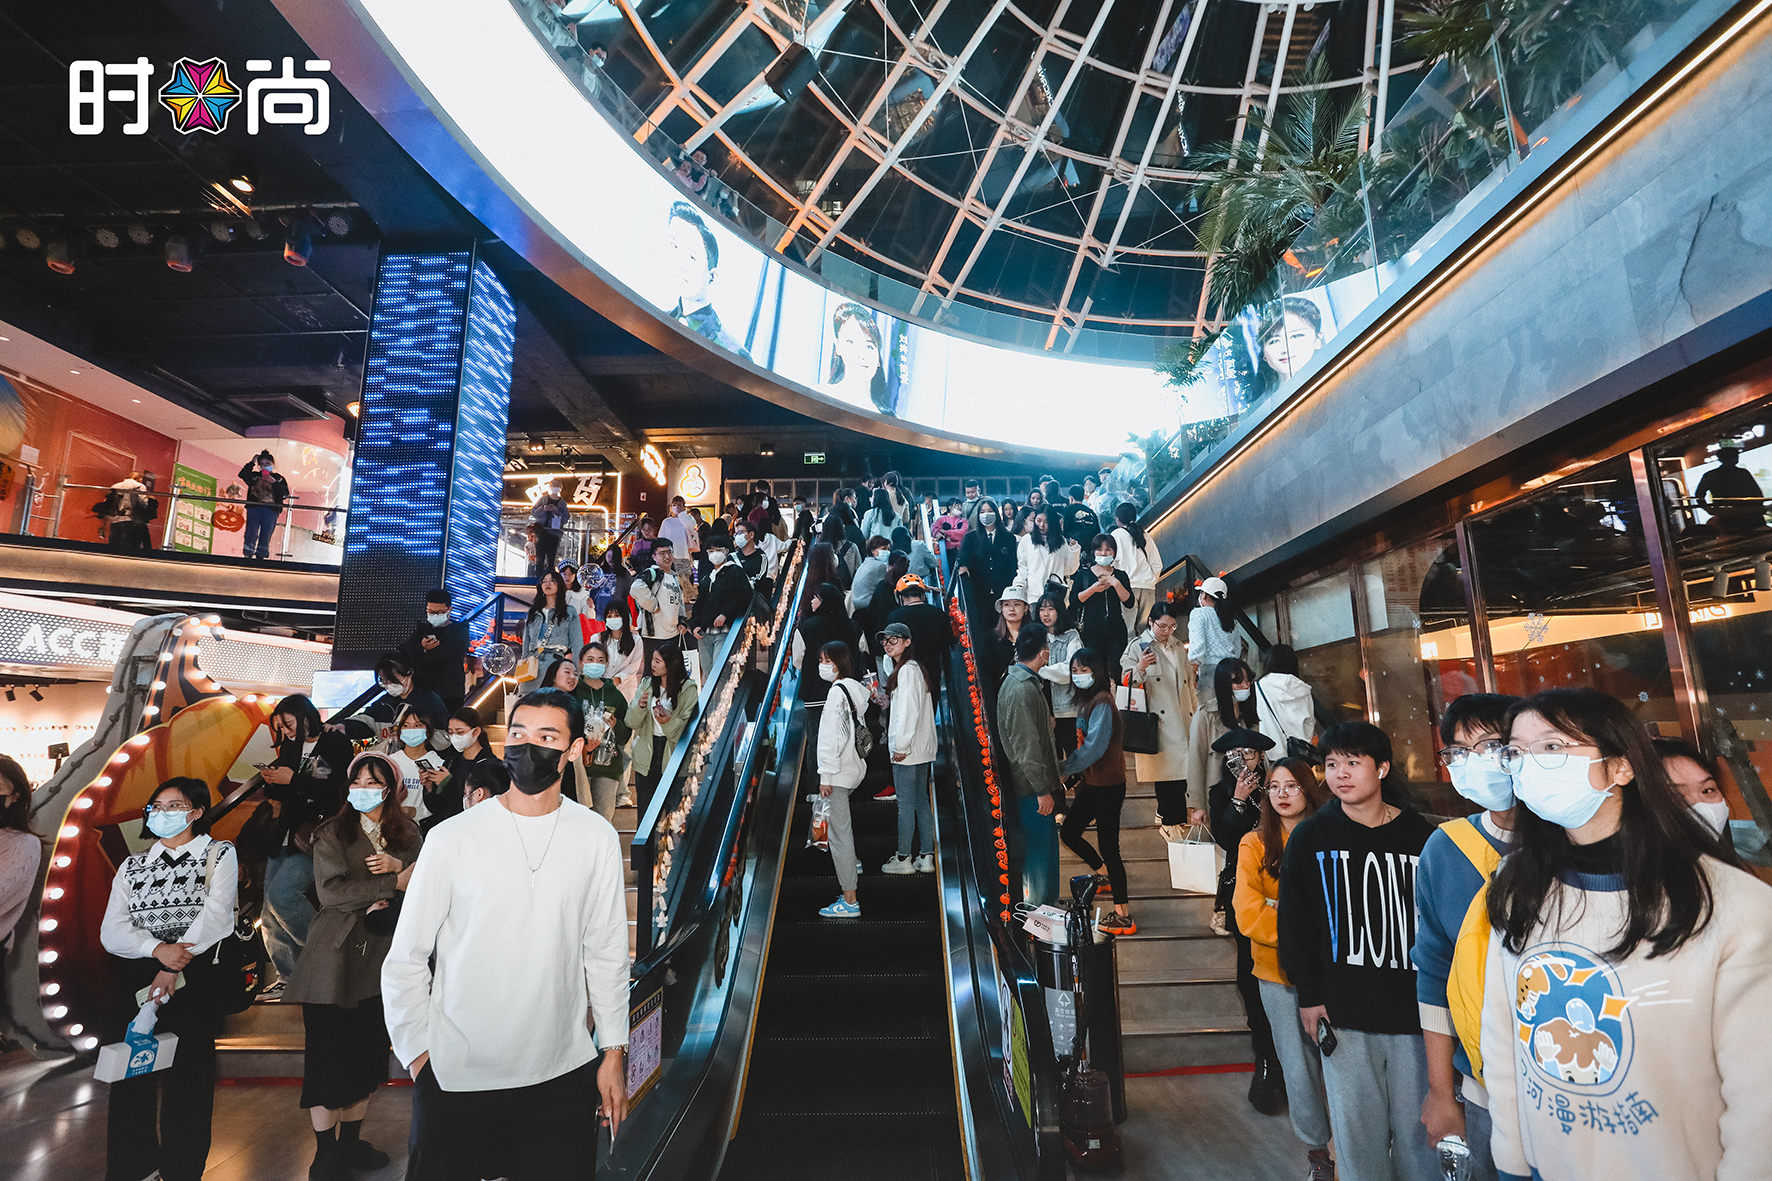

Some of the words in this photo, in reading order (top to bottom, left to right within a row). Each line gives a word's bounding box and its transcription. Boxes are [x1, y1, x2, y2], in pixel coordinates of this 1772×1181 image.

[1522, 1059, 1659, 1135] 河漫游指南
